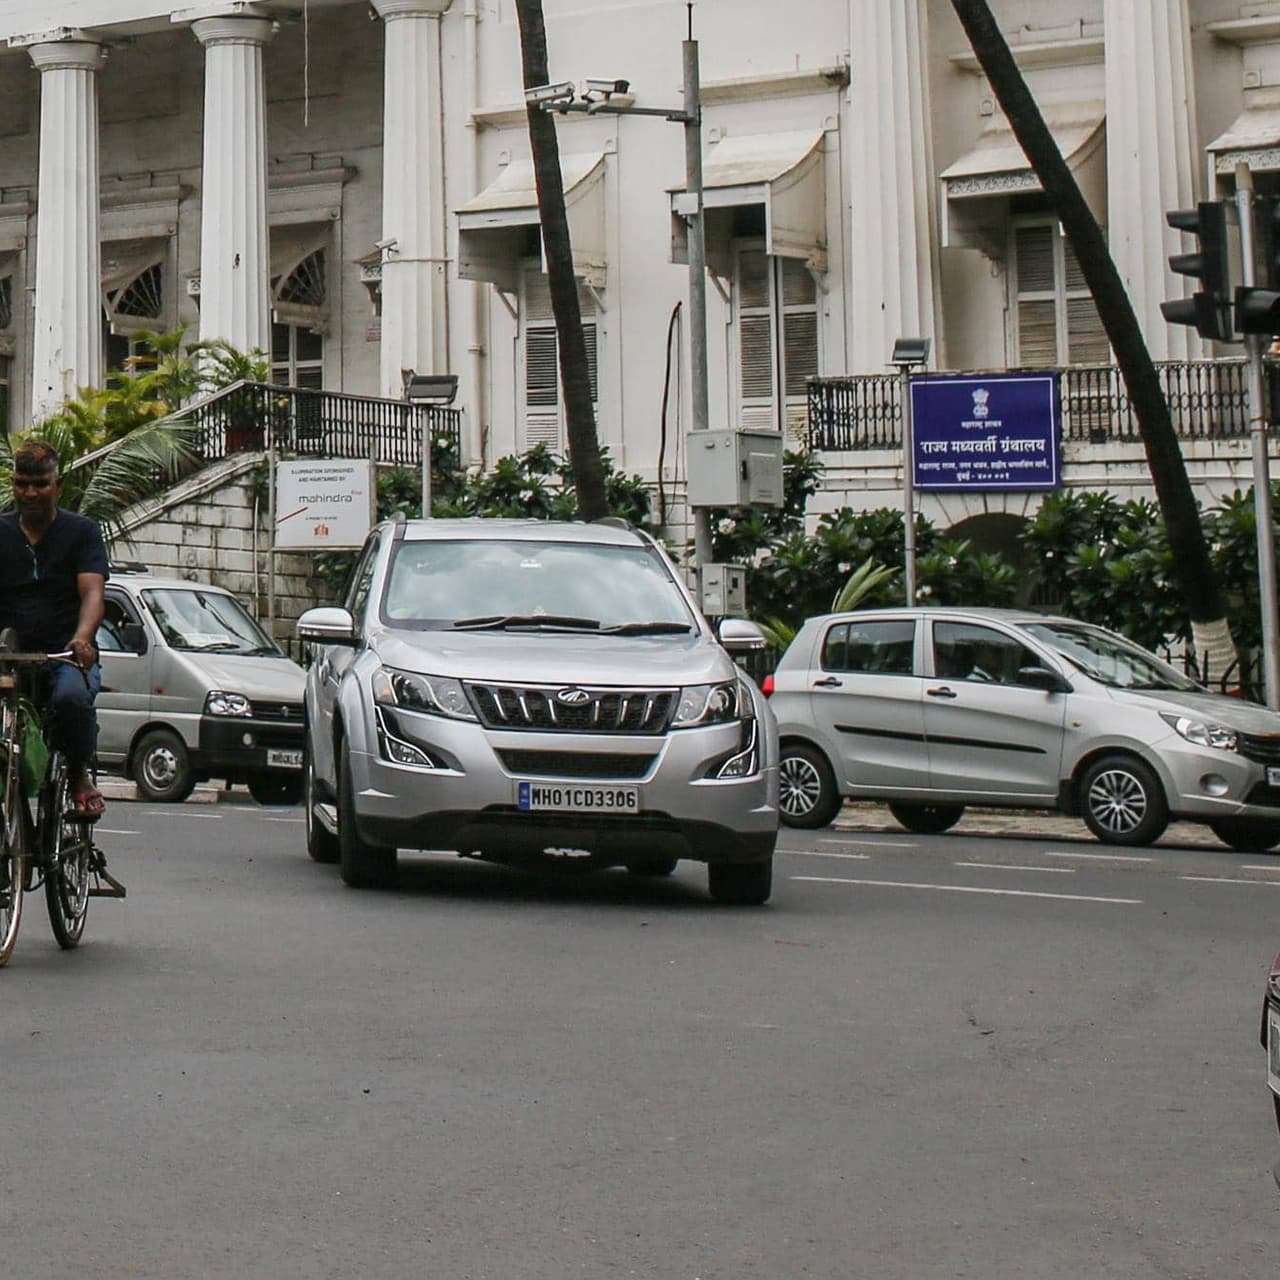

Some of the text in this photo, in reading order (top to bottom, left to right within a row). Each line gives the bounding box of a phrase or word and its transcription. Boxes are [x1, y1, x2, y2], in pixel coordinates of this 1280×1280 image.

[920, 440, 948, 453] राज्य
[299, 493, 352, 503] mahindra
[532, 788, 636, 808] MH01CD3306
